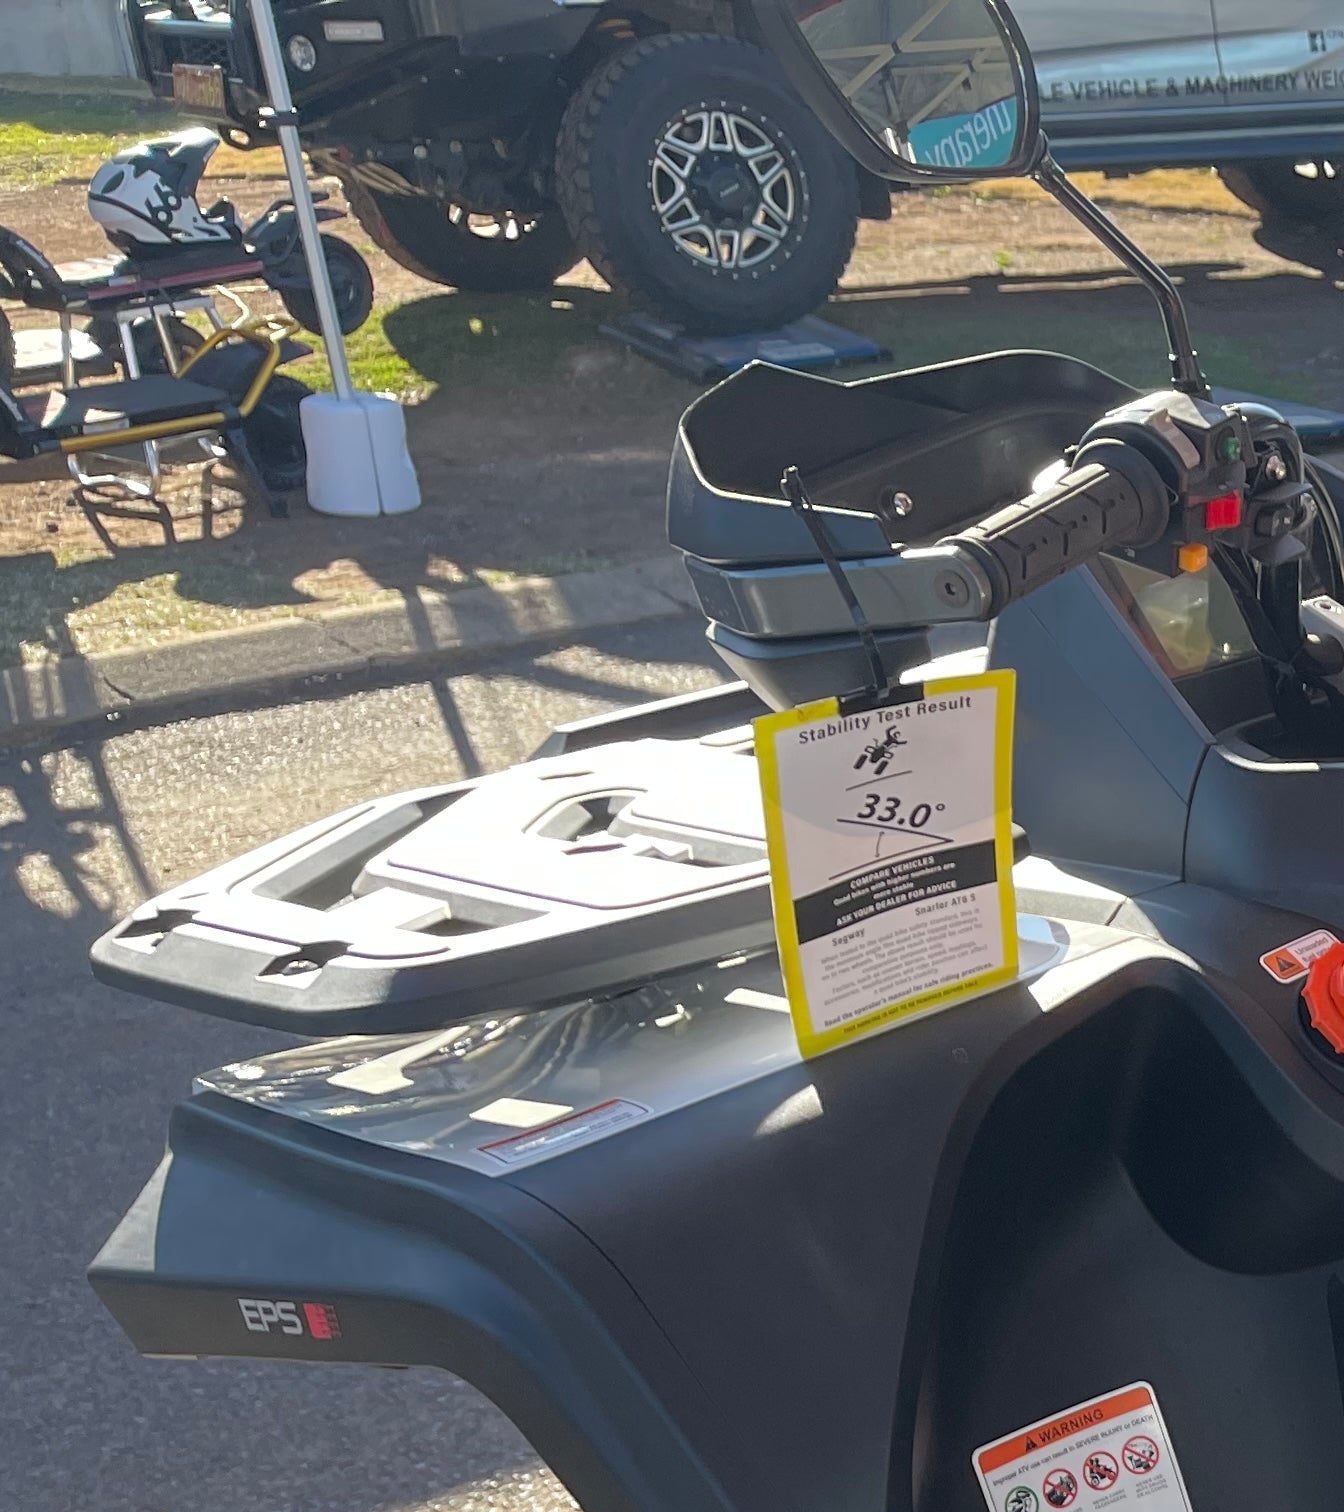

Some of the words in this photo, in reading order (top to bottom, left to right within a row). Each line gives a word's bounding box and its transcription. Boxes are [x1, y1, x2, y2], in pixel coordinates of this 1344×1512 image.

[1069, 77, 1162, 101] VEHICLE
[1164, 76, 1179, 96] &
[1184, 71, 1299, 95] MACHINERY
[799, 715, 871, 745] Stability
[877, 706, 911, 724] Test
[917, 696, 972, 716] Result
[857, 793, 946, 829] 33.0°
[850, 867, 891, 889] COMPARE
[892, 856, 936, 874] VEHICLES
[836, 914, 853, 927] ASK
[854, 905, 875, 919] YOUR
[875, 893, 907, 911] DEALER
[908, 888, 925, 901] FOR
[926, 880, 957, 896] ADVICE
[915, 900, 948, 916] Snarler
[832, 928, 865, 947] Segway
[238, 1299, 304, 1335] EPS
[1039, 1408, 1104, 1442] WARNING
[1017, 1463, 1030, 1476] ATV
[1075, 1432, 1100, 1450] SEVERE
[1131, 1414, 1154, 1428] DEATH
